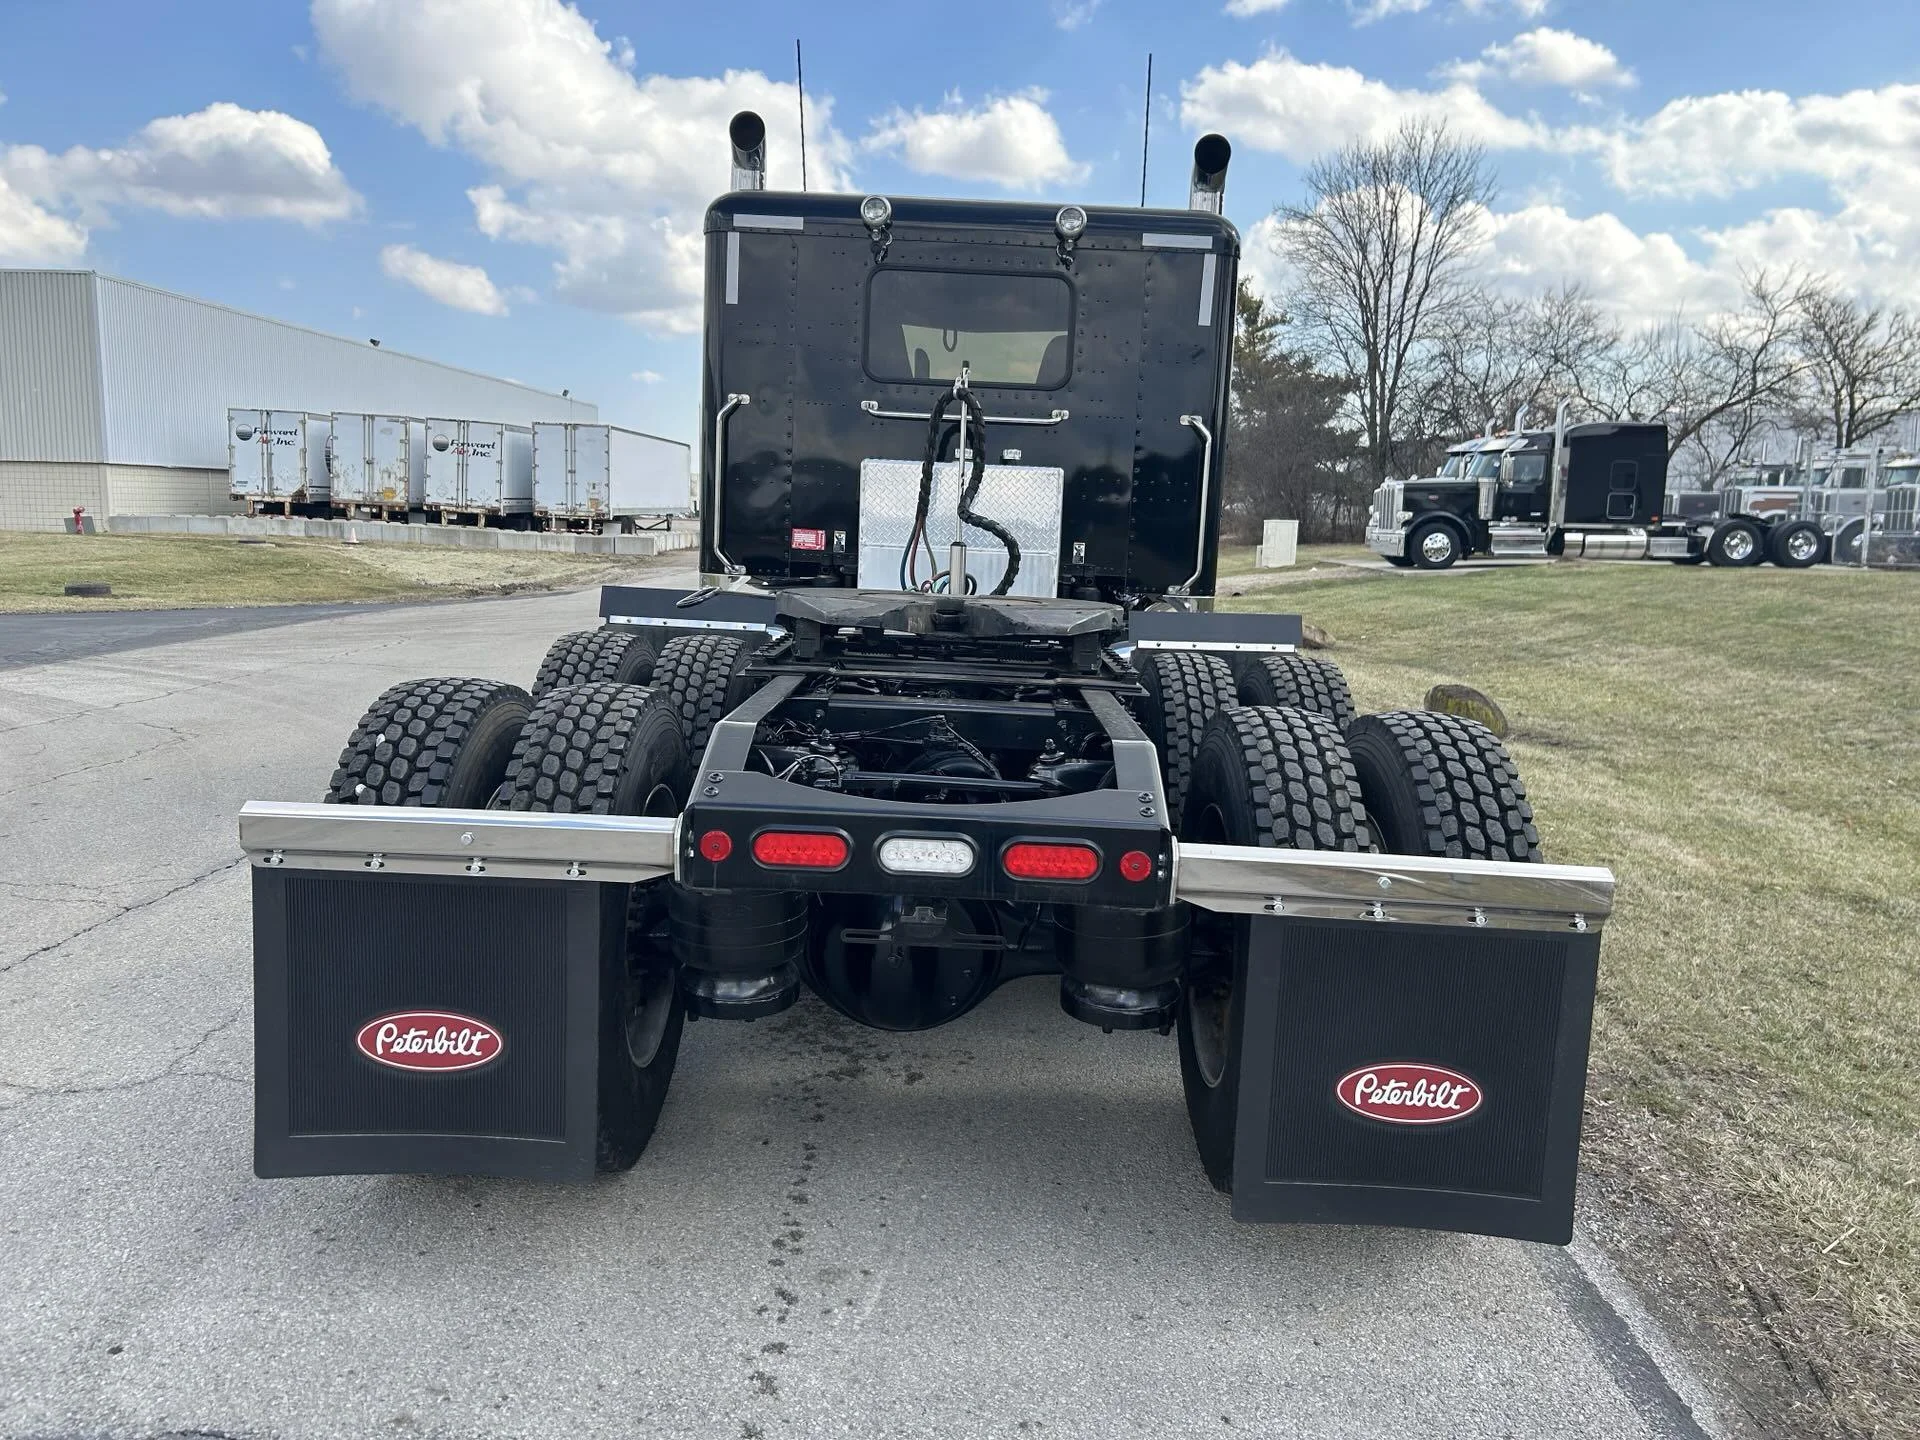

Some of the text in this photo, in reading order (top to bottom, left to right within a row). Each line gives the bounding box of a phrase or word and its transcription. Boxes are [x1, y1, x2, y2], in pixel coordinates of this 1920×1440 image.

[253, 426, 298, 437] Forward
[450, 439, 496, 450] Forward
[375, 1022, 491, 1056] Peterbilt
[1354, 1073, 1471, 1110] Peterbilt
